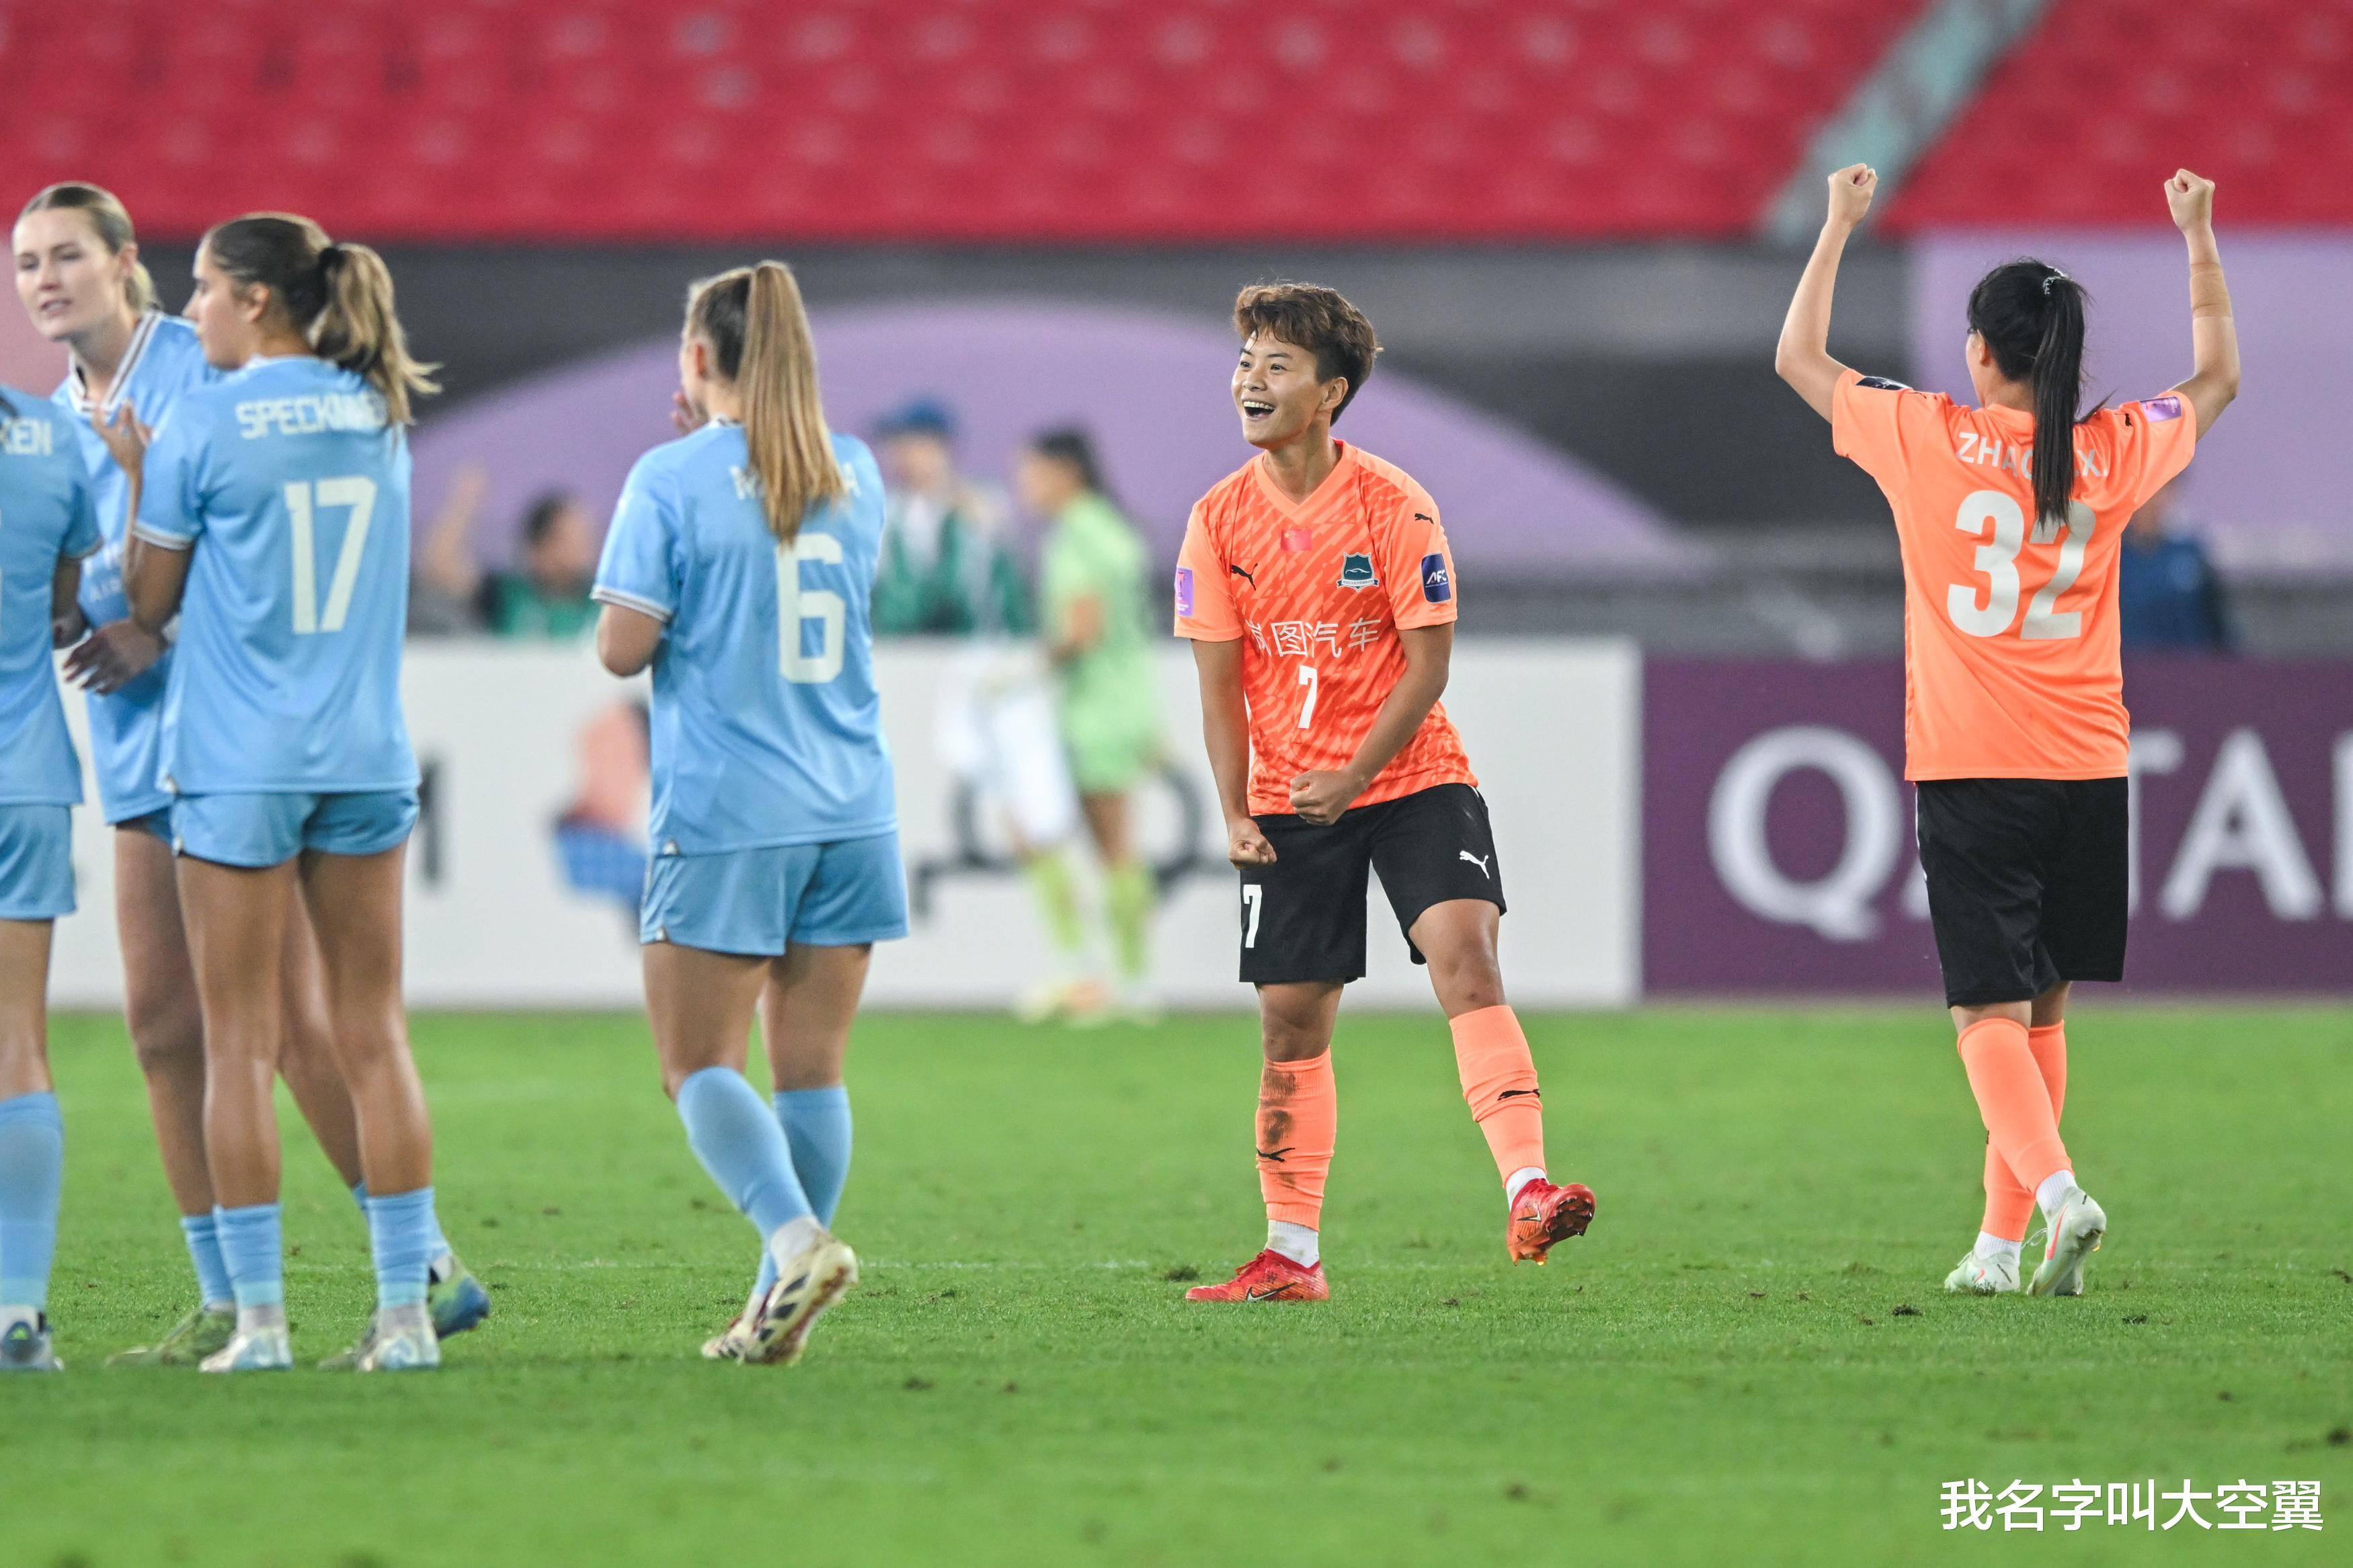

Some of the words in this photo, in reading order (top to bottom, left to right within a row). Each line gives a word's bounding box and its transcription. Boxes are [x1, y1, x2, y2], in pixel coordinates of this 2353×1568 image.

[284, 477, 377, 634] 17
[775, 532, 846, 684] 6
[1426, 569, 1447, 585] AFC
[1947, 489, 2096, 641] 32
[1298, 665, 1318, 729] 7
[1243, 884, 1263, 948] 7
